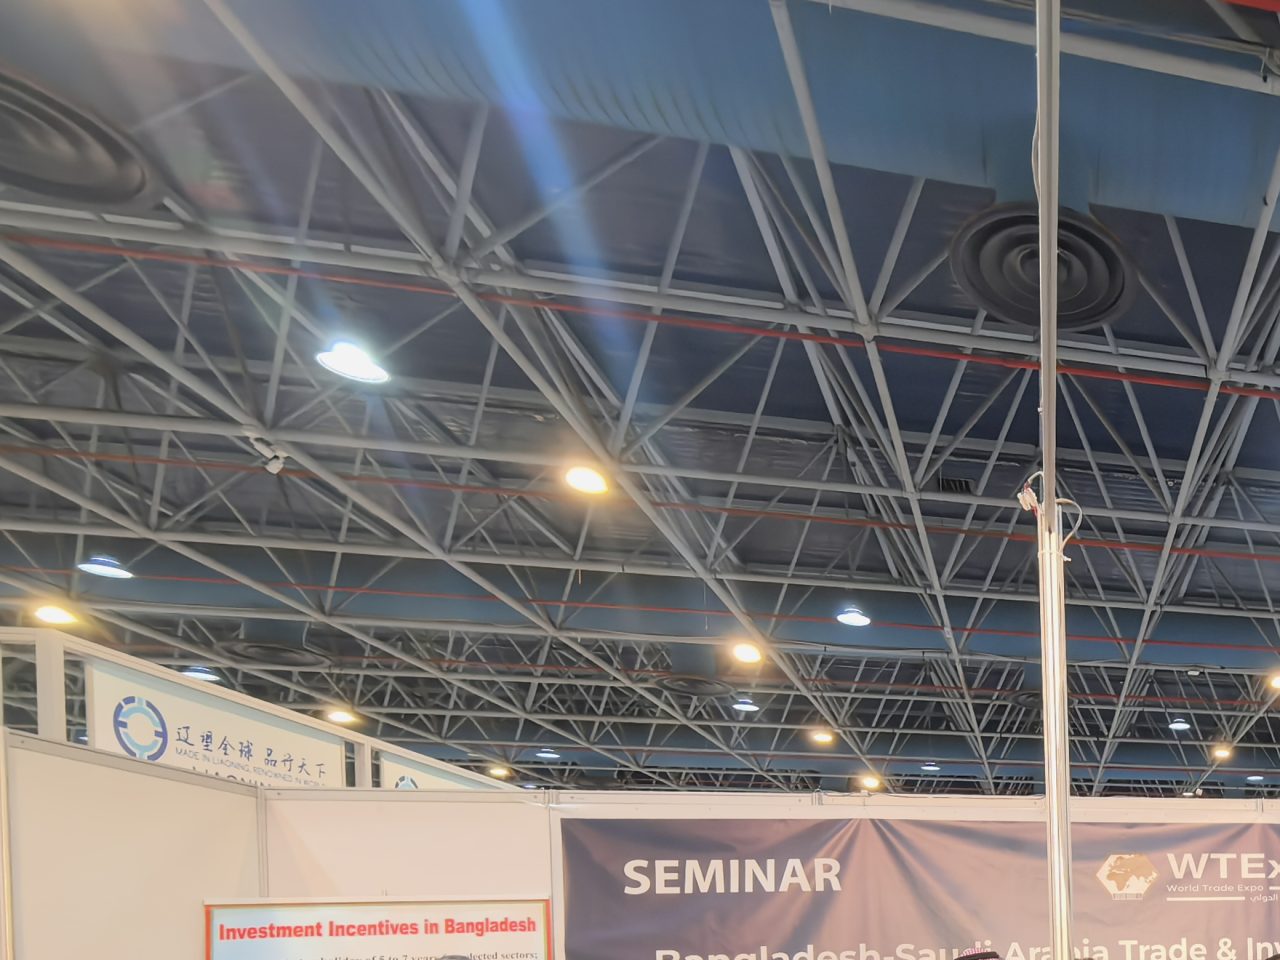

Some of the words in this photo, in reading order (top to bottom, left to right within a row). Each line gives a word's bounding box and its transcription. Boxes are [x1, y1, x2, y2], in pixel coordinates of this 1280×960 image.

[623, 857, 843, 895] SEMINAR
[1166, 884, 1199, 892] World
[1201, 884, 1234, 892] Trade
[1237, 884, 1264, 893] Expo
[1249, 892, 1278, 903] الدولي
[219, 921, 323, 941] Investment
[328, 918, 419, 937] Incentives
[424, 918, 439, 935] in
[444, 916, 537, 937] Bangladesh
[469, 952, 498, 960] lected
